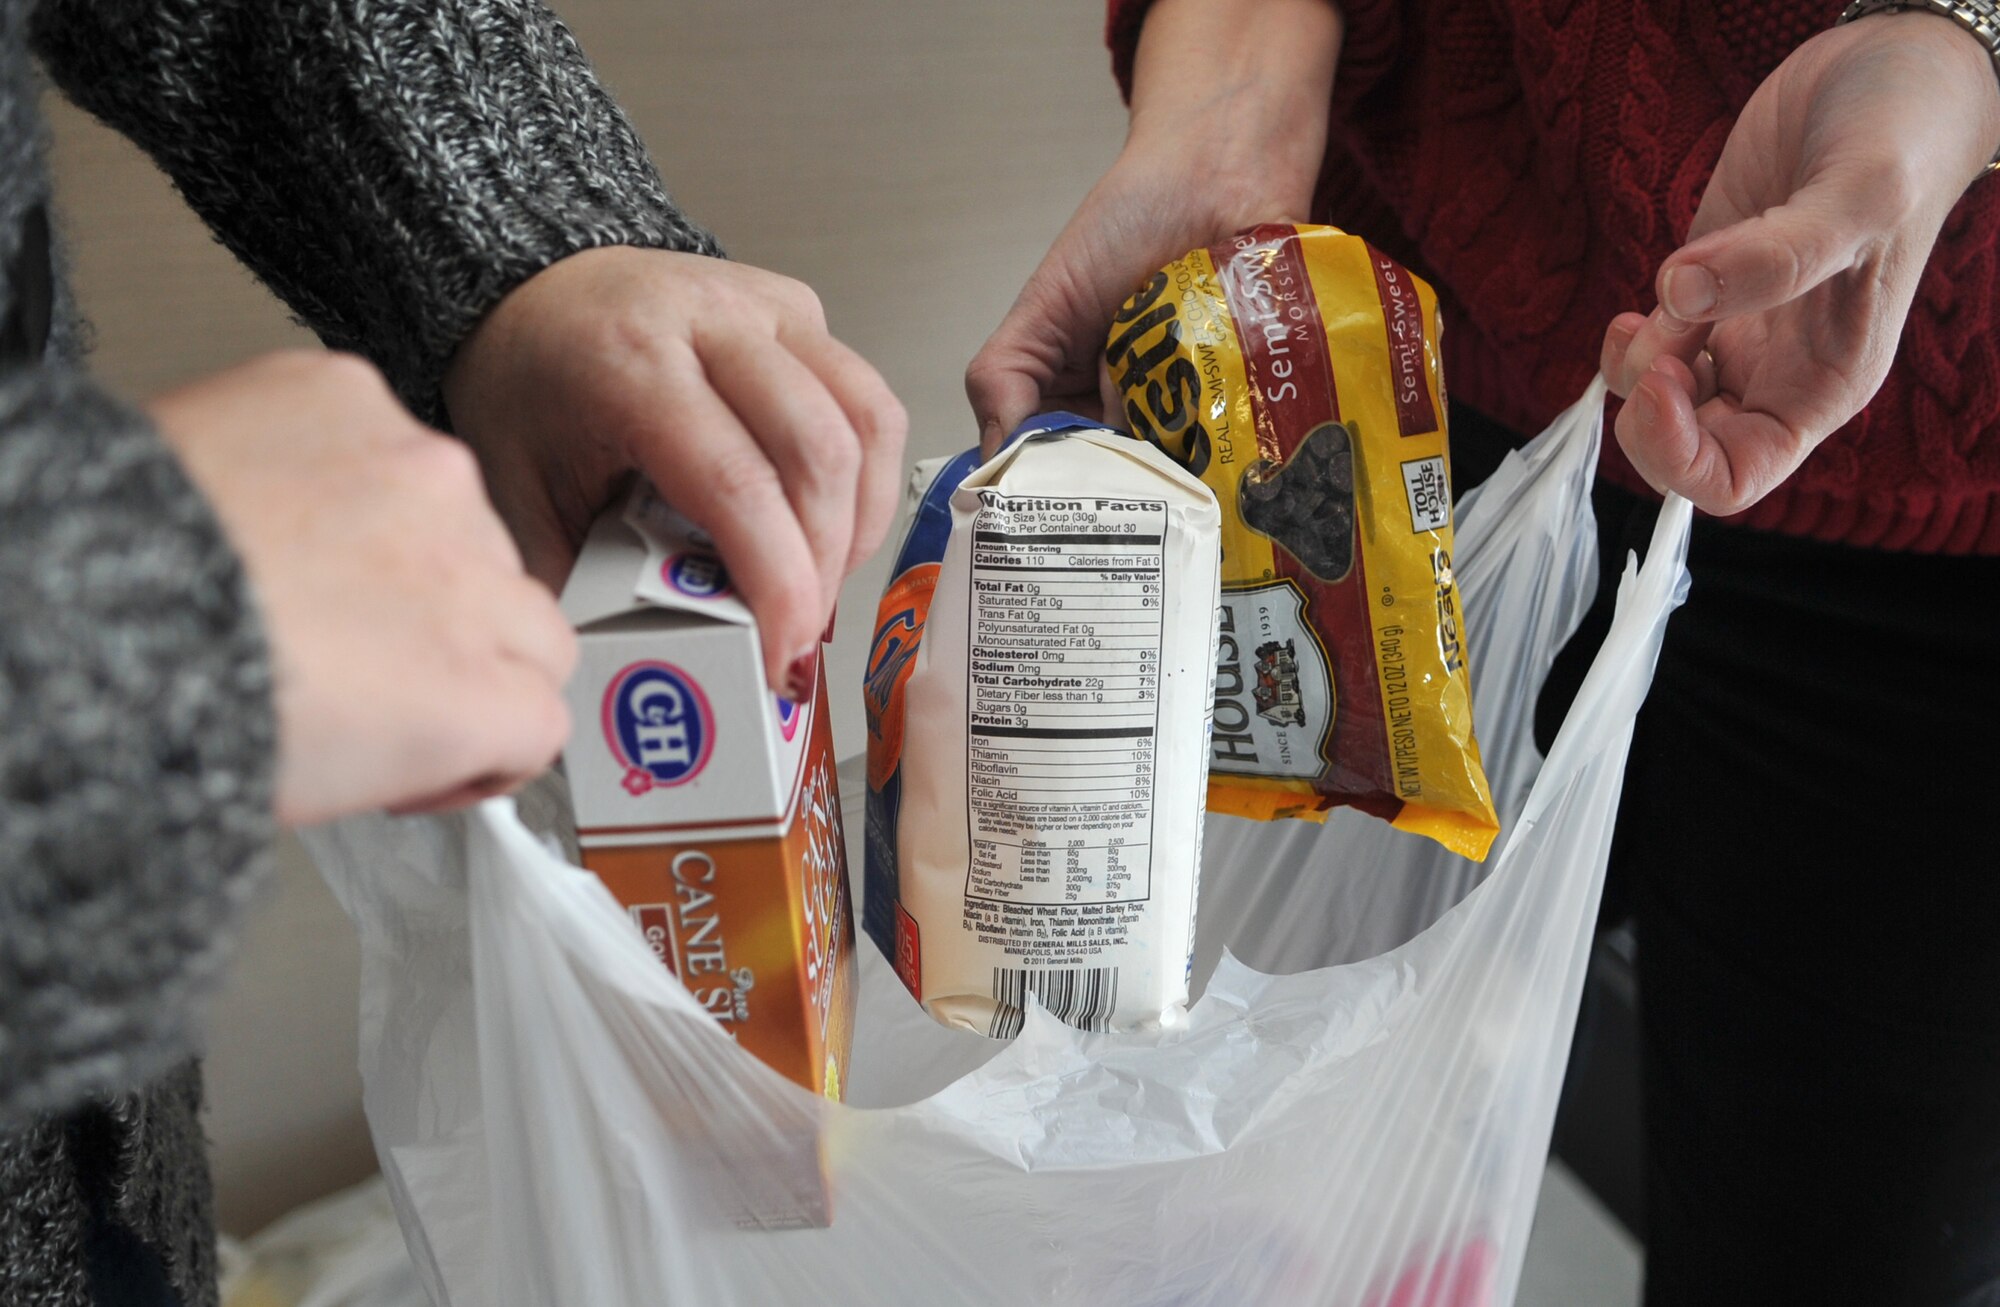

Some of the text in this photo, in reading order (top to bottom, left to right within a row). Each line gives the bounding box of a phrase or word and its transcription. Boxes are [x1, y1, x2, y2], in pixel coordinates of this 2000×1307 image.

[1380, 260, 1418, 403] Semi-Sweet
[1216, 420, 1234, 465] REAL
[1411, 472, 1428, 518] TOLL
[1421, 462, 1440, 524] HOUSE
[982, 494, 1162, 512] Nutrition Facts
[979, 510, 1010, 524] Serving
[1014, 513, 1034, 522] Size
[1050, 514, 1069, 523] cup
[1073, 513, 1097, 523] (30g)
[976, 522, 1136, 533] Servings Per Container about 30
[975, 543, 1007, 551] Amount
[975, 554, 1159, 566] Calories 110 Calories from Fat 0
[974, 582, 1159, 594] Total Fat 0g 0%
[979, 595, 1027, 606] Saturated
[1031, 598, 1046, 606] Fat
[1050, 598, 1062, 609] 0g
[978, 609, 1040, 622] Trans Fat 0g
[1259, 606, 1272, 637] 1939
[978, 622, 1094, 635] Polyunsaturated Fat 0g
[1377, 624, 1404, 636] g)
[978, 636, 1100, 648] Monounsaturated Fat 0g
[973, 648, 1156, 662] Cholesterol 0mg 0%
[1380, 640, 1406, 664] (340
[972, 662, 1014, 672] Sodium
[1018, 664, 1040, 675] 0mg
[1384, 665, 1406, 682] OZ
[972, 675, 1155, 689] Total Carbohydrate 22g 7%
[1387, 682, 1406, 696] 12
[977, 689, 1154, 702] Dietary Fiber less than 1g 3%
[977, 702, 1026, 714] Sugars 0g
[1388, 698, 1412, 728] NETO
[971, 714, 1028, 727] Protein 3g
[972, 736, 989, 746] Iron
[1276, 731, 1292, 764] SINCE
[972, 749, 1151, 760] Thiamin 10%
[972, 762, 1151, 773] Riboflavin 8%
[972, 775, 1150, 785] Niacin 8%
[972, 787, 1149, 799] Folic Acid 10%
[1400, 780, 1421, 797] NET
[1022, 839, 1046, 847] Calories
[1108, 838, 1124, 846] 2,500
[973, 858, 1002, 869] Cholesterol
[972, 867, 991, 876] Sodium
[1066, 875, 1092, 883] 2,400mg
[1107, 873, 1131, 881] 2,400mg
[671, 850, 726, 976] CANE
[965, 898, 1144, 916] Ingredients: Bleached Wheat Flour, Malted Barley Flour,
[964, 909, 982, 920] Niacin
[994, 914, 998, 923] B
[1002, 915, 1026, 927] vitamin),
[1030, 918, 1045, 927] Iron,
[1049, 918, 1074, 926] Thiamin
[1078, 916, 1114, 925] Mononitrate
[1118, 914, 1139, 925] (vitamin
[976, 922, 1006, 934] Riboflavin
[1010, 927, 1033, 937] (vitamin
[1052, 929, 1067, 937] Folic
[1071, 928, 1085, 936] Acid
[1097, 927, 1102, 935] B
[1105, 925, 1128, 935] vitamin).
[978, 935, 1021, 946] DISTRIBUTED
[1004, 947, 1052, 956] MINNEAPOLIS,
[730, 966, 754, 1020] Pure
